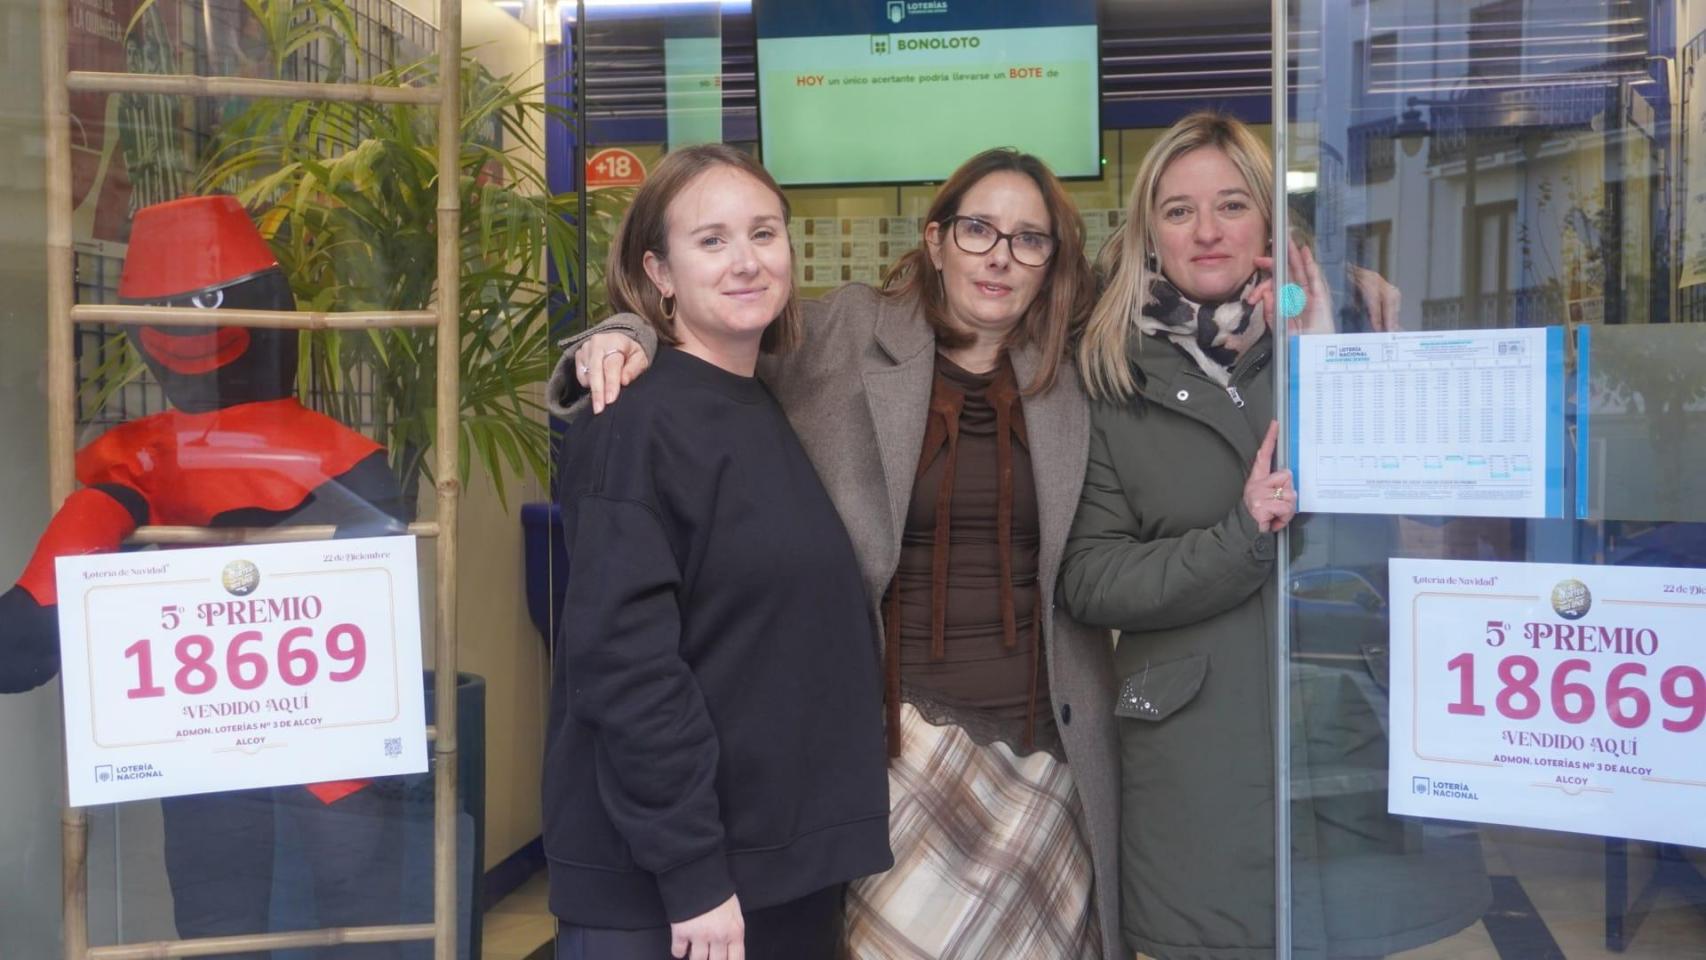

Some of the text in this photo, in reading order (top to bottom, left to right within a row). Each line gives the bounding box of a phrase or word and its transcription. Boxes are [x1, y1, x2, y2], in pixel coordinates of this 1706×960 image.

[897, 36, 980, 51] BONOLOTO
[797, 76, 825, 87] HOY
[828, 78, 840, 86] un
[843, 75, 868, 86] único
[871, 75, 915, 84] acertante
[952, 71, 990, 82] llevarse
[994, 71, 1006, 80] un
[1009, 67, 1042, 79] BOTE
[1047, 69, 1059, 78] de
[595, 155, 632, 178] +18
[322, 551, 391, 562] 22 de Diciembre
[118, 569, 130, 577] de
[1446, 576, 1457, 585] de
[1663, 584, 1674, 593] 22
[1676, 584, 1688, 593] de
[197, 595, 323, 628] PREMIO
[1524, 621, 1659, 656] PREMIO
[124, 622, 367, 700] 18669
[1447, 652, 1706, 734] 18669
[183, 692, 310, 720] VENDIDO AQUÍ
[176, 726, 213, 738] ADMON.
[215, 720, 259, 735] LOTERÍAS
[272, 720, 279, 729] 3
[280, 719, 291, 728] DE
[292, 716, 323, 727] ALCOY
[235, 736, 266, 746] ALCOY
[1502, 730, 1638, 757] VENDIDO AQUÍ
[116, 763, 153, 774] LOTERÍA
[1493, 754, 1532, 765] ADMON.
[1534, 756, 1581, 770] LOTERÍAS
[1596, 763, 1603, 771] 3
[1604, 763, 1618, 773] DE
[1619, 764, 1652, 776] ALCOY
[116, 769, 164, 781] NACIONAL
[1555, 775, 1589, 786] ALCOY
[1433, 780, 1469, 792] LOTERÍA
[1433, 788, 1479, 801] NACIONAL
